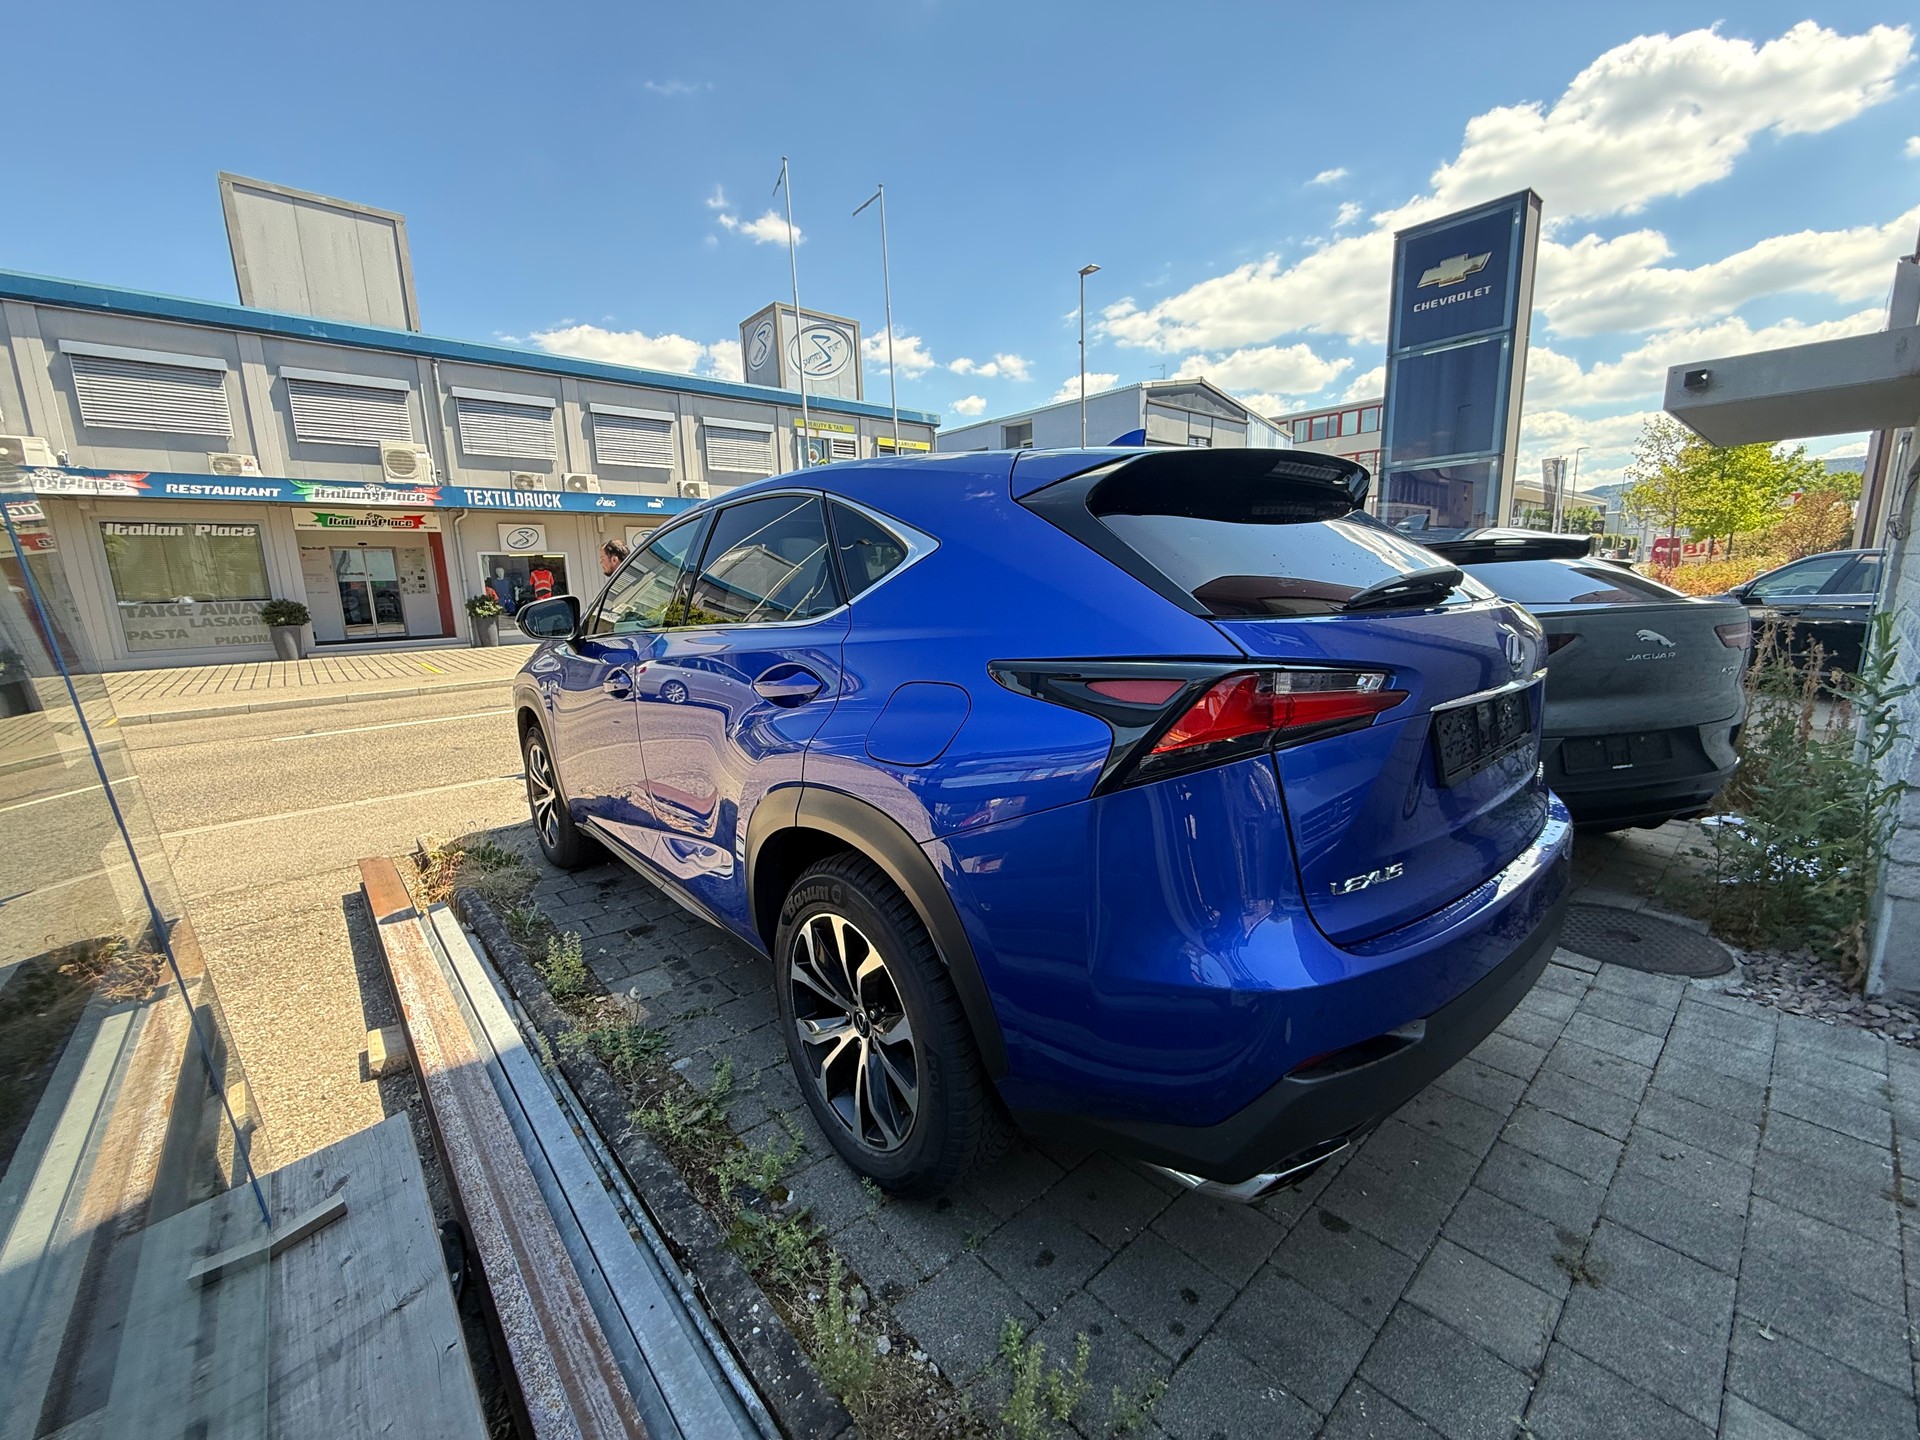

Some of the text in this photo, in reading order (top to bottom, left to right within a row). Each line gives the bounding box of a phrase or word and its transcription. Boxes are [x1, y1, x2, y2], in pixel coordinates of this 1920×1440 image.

[1413, 285, 1492, 313] CHEVROLET
[58, 478, 128, 492] Place
[165, 483, 281, 498] RESTAURANT
[314, 487, 426, 503] Italian Place
[464, 489, 562, 509] TEXTILDRUCK
[328, 516, 372, 528] Italian
[377, 518, 413, 528] Place
[105, 523, 257, 537] Italian Place
[120, 604, 194, 619] TAKE
[189, 615, 266, 629] LASAGN
[126, 628, 190, 641] PASTA
[1624, 651, 1677, 661] JAGUAR
[1329, 862, 1404, 896] LEXUS
[783, 885, 830, 919] Barum
